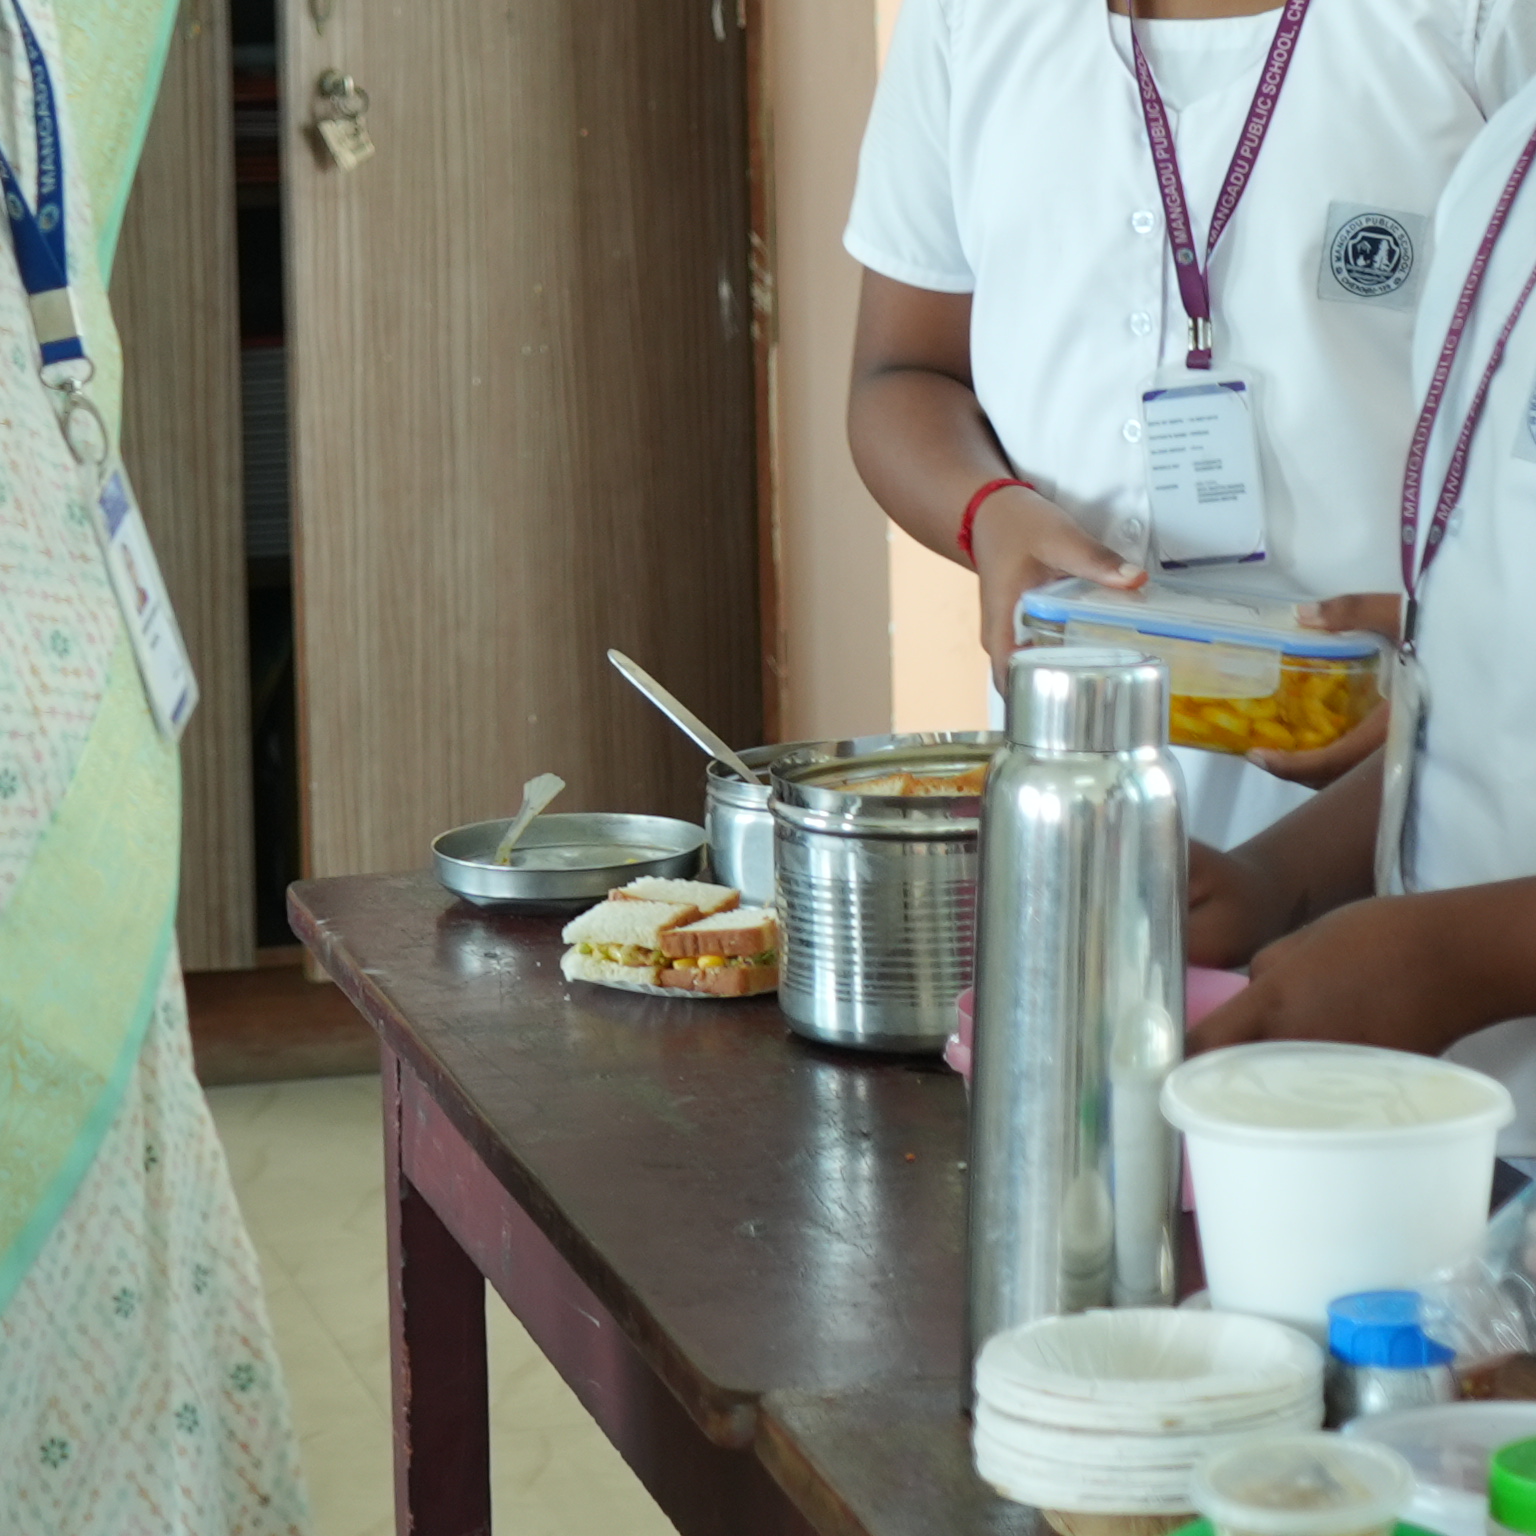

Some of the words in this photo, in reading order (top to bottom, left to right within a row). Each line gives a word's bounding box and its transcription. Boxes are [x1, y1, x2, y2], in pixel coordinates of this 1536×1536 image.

[33, 64, 57, 194] MANGADU
[1145, 102, 1171, 159] PUBLIC
[1209, 159, 1250, 245] MANGADU
[1240, 97, 1273, 159] PUBLIC
[1161, 163, 1189, 243] MANGADU
[1365, 216, 1399, 233] PUBLIC
[1397, 233, 1410, 274] SCHOOL
[1403, 413, 1434, 518] MANGADU
[1426, 335, 1457, 408] PUBLIC
